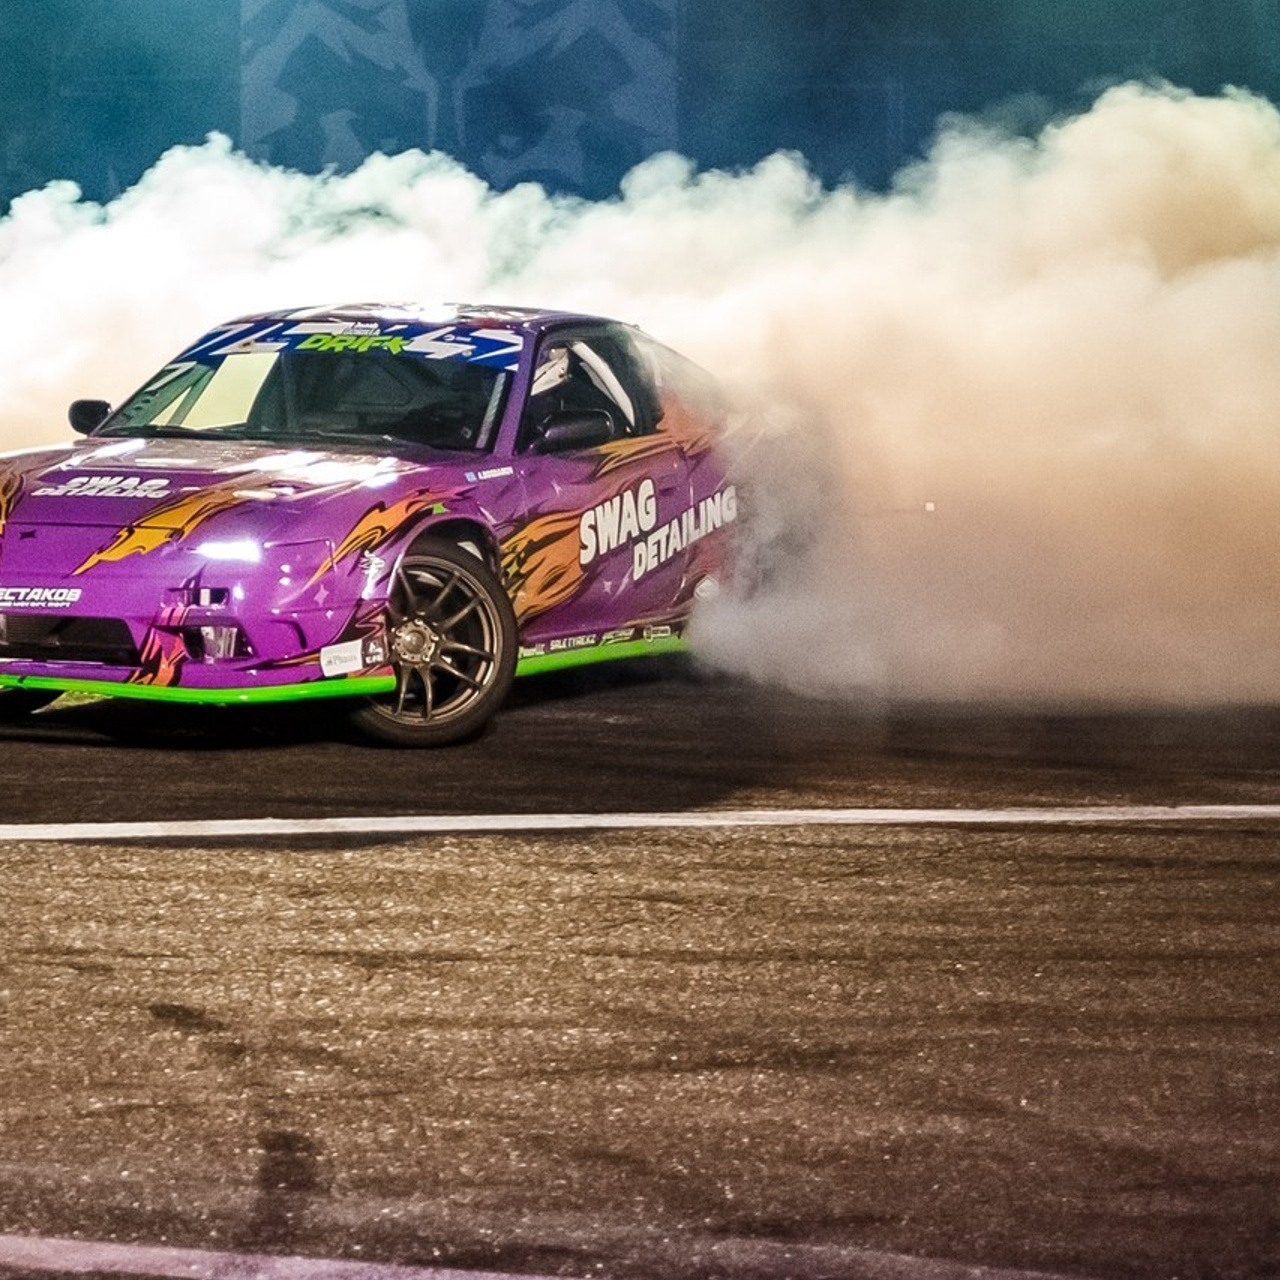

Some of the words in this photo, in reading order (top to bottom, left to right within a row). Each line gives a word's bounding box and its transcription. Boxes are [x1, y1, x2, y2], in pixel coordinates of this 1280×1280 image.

[30, 484, 171, 499] DETAILING
[64, 476, 170, 490] SWAG
[579, 478, 657, 565] SWAG
[632, 485, 738, 582] DETAILING
